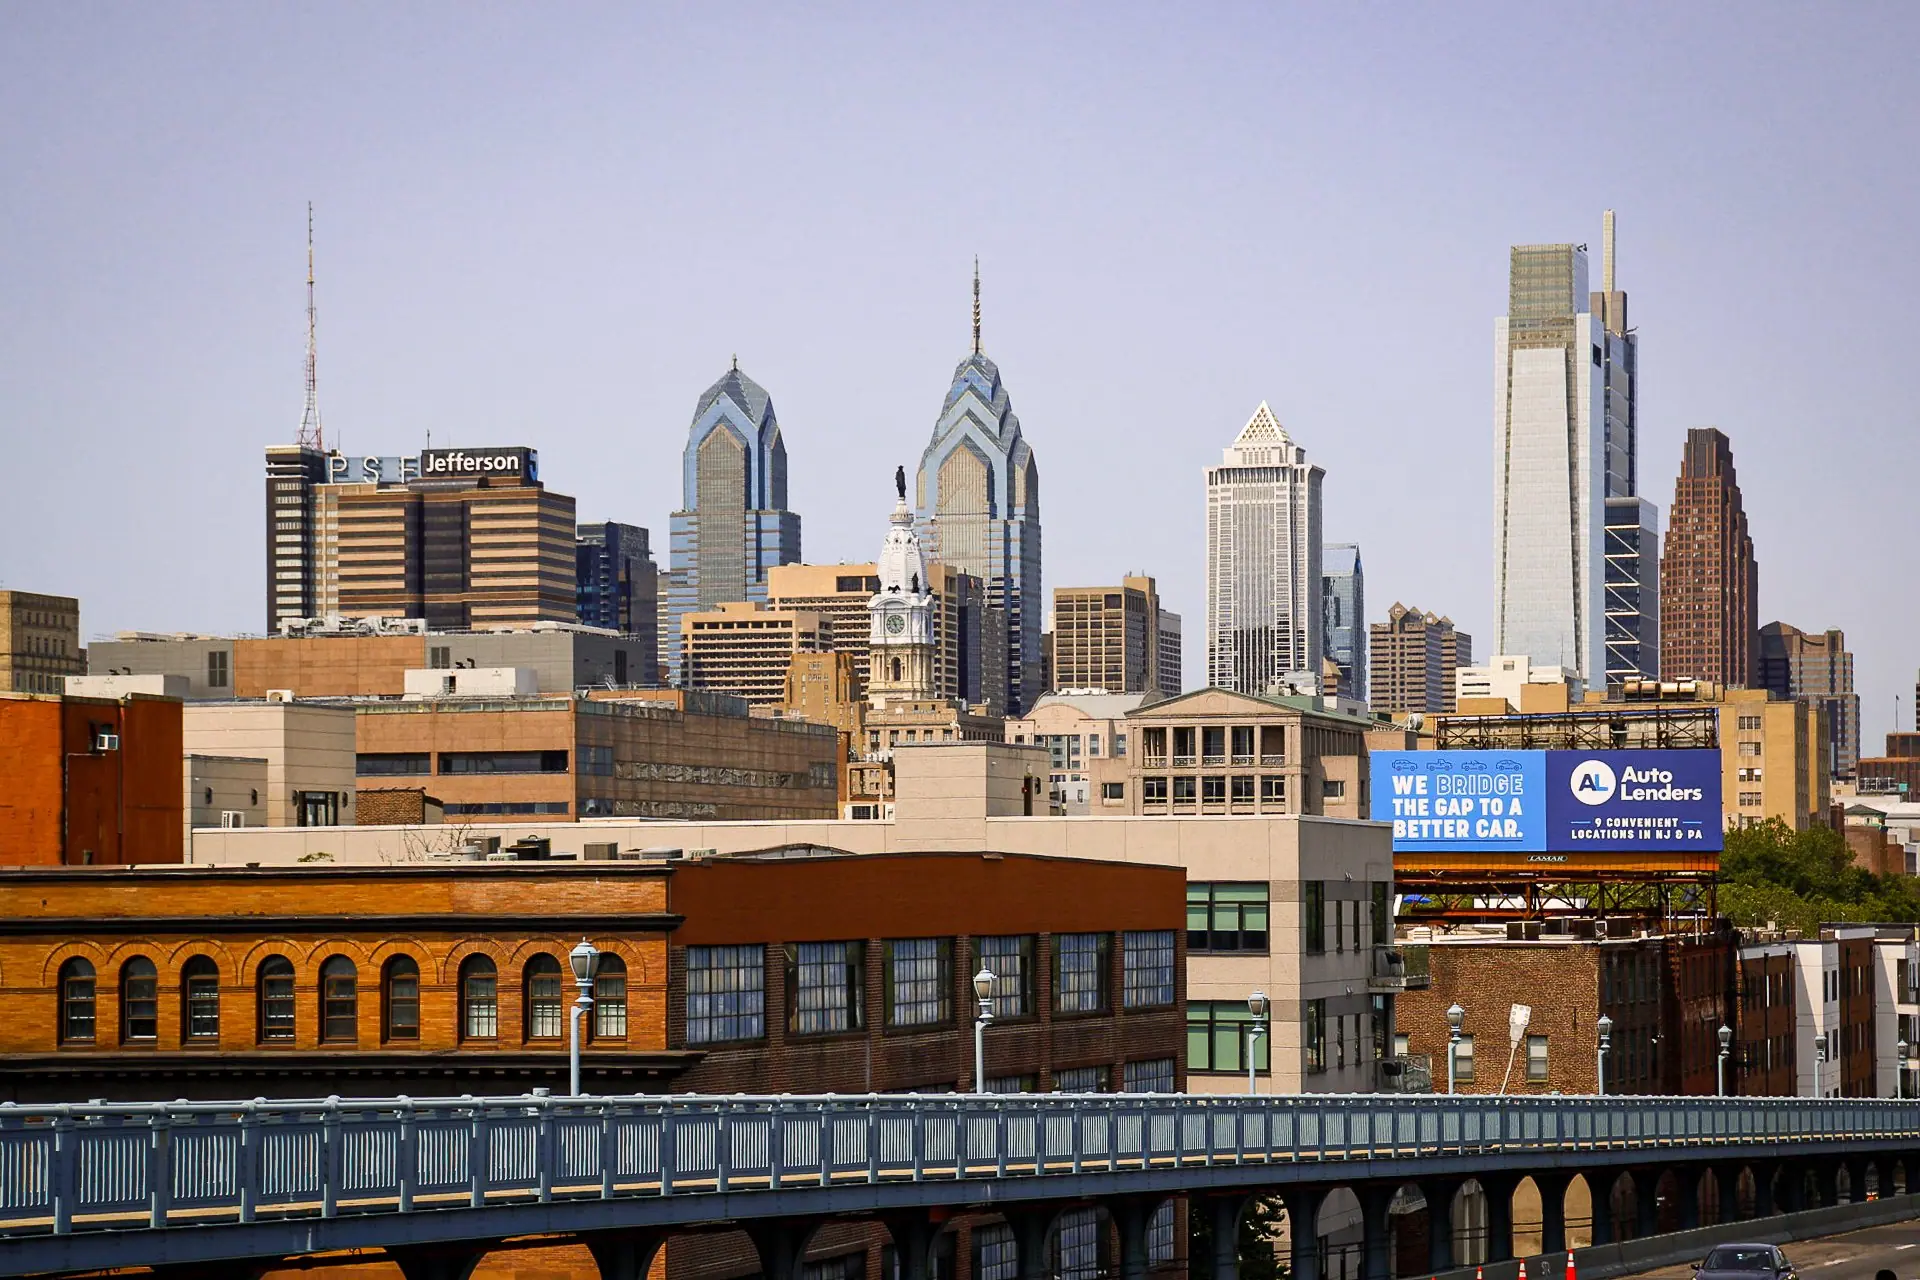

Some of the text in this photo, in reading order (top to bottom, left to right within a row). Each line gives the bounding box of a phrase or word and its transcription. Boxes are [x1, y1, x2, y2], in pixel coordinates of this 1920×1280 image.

[426, 452, 519, 473] Jefferson
[1578, 773, 1609, 791] AL
[1620, 765, 1673, 783] Auto
[1392, 774, 1523, 796] WE BRIDGE
[1620, 783, 1703, 801] Lenders
[1392, 797, 1523, 816] THE GAP TO A
[1393, 818, 1524, 838] BETTER CAR.
[1594, 817, 1679, 828] 9 CONVENIENT
[1571, 829, 1703, 839] LOCATIONS IN NJ & PA
